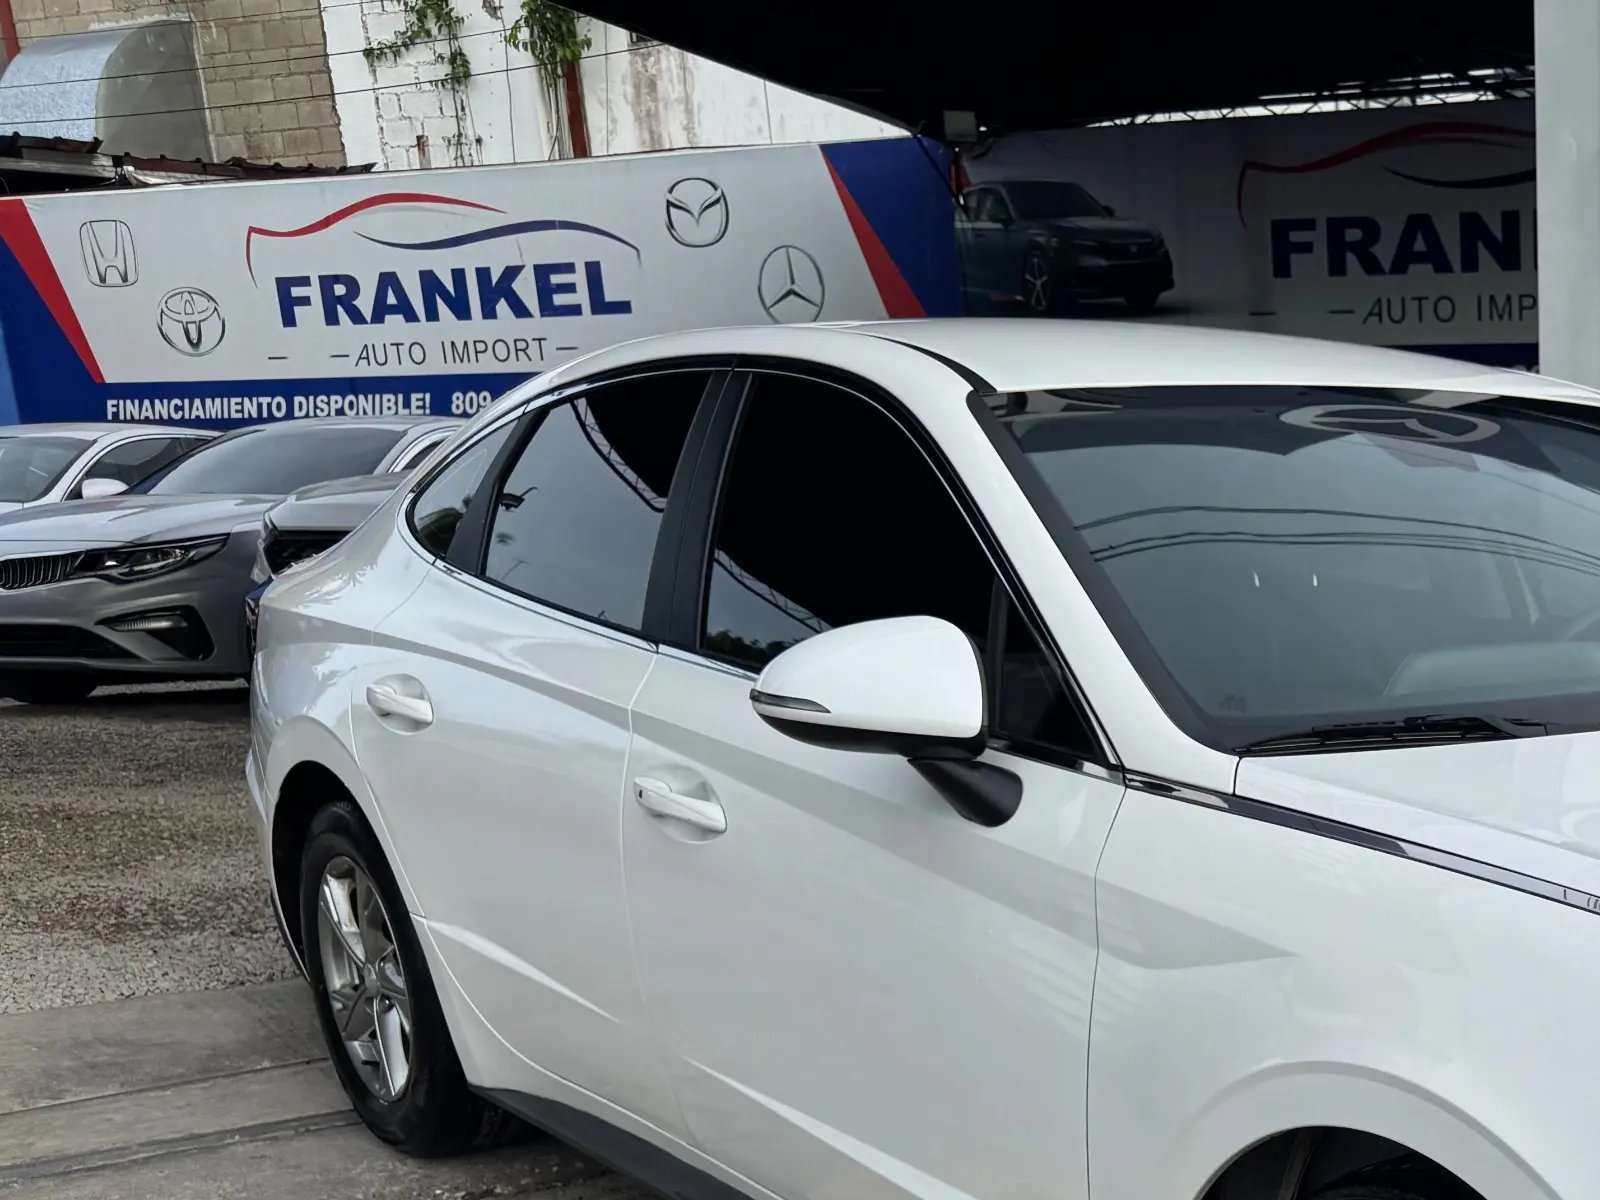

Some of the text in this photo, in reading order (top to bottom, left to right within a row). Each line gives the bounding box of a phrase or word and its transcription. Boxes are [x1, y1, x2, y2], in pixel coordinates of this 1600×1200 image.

[274, 260, 633, 329] FRANKEL
[1362, 293, 1537, 325] AUTO IMP
[355, 337, 548, 368] AUTO IMPORT
[107, 396, 288, 421] FINANCIAMIENTO
[294, 393, 431, 418] DISPONIBLE!
